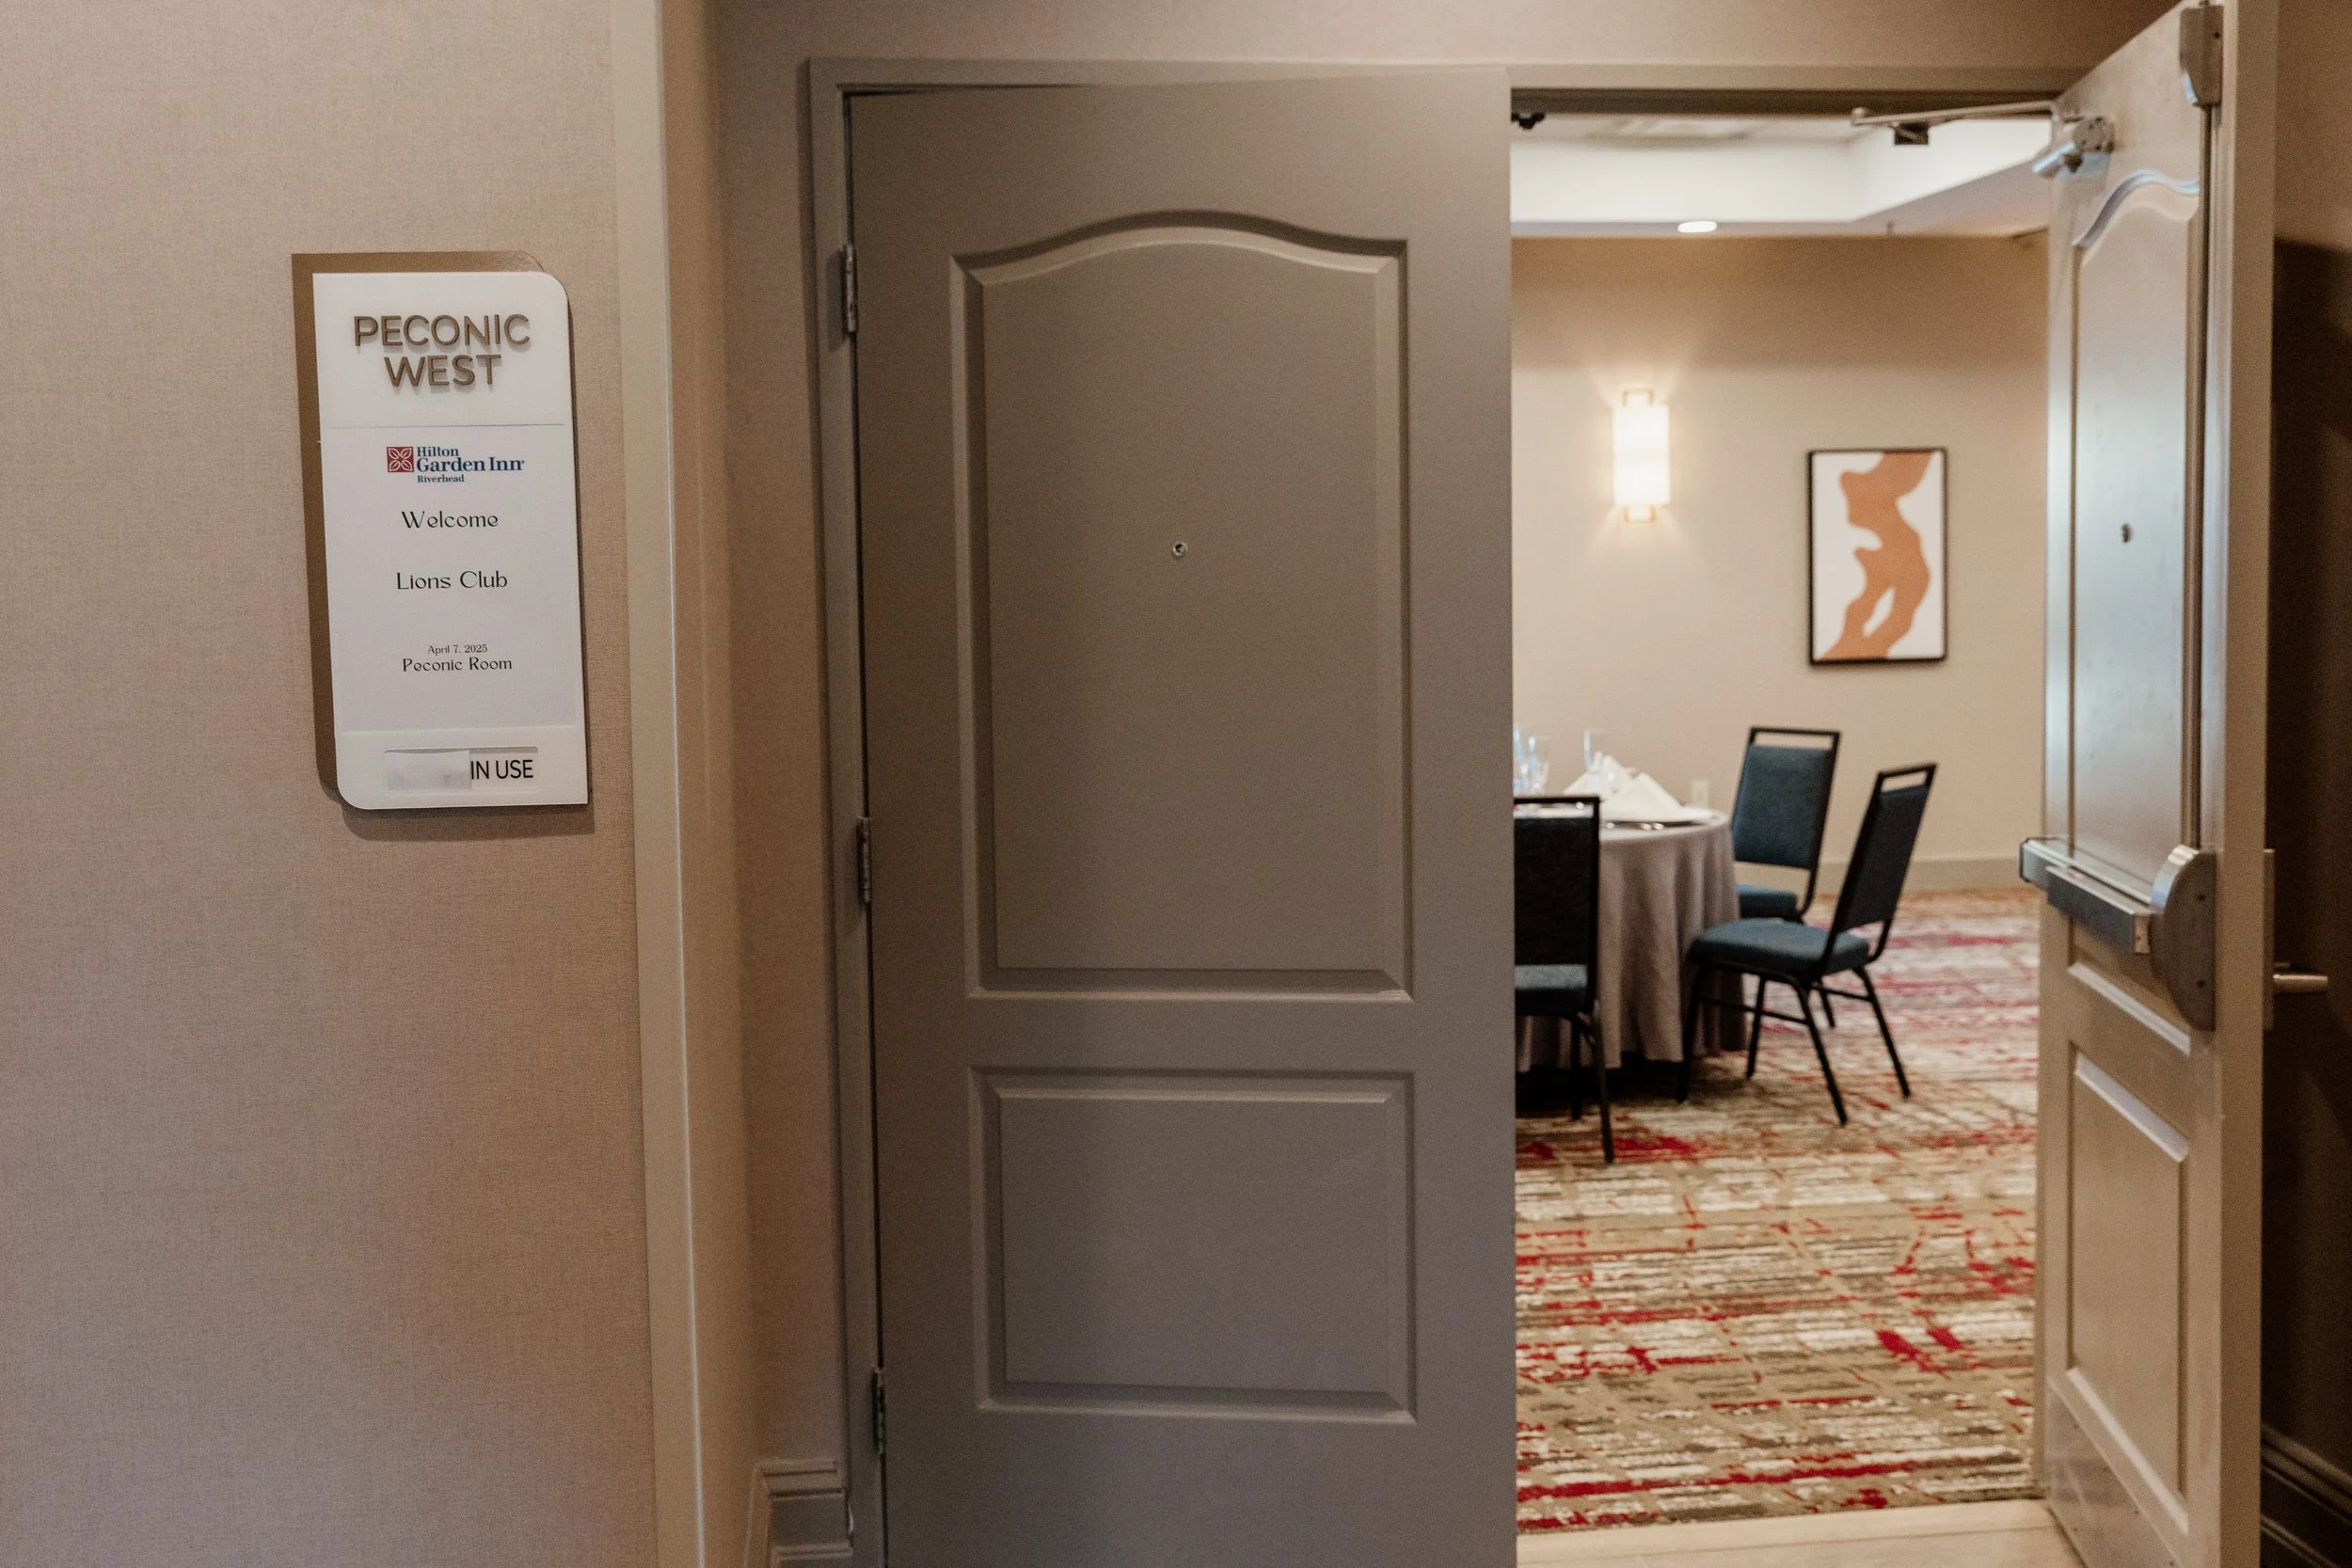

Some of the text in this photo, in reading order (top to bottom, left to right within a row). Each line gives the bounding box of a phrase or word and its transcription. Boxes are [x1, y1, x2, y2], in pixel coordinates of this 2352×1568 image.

[354, 314, 531, 347] PECONIC
[384, 354, 501, 388] WEST
[417, 446, 459, 457] Hilton
[416, 457, 486, 472] Garden
[417, 475, 465, 483] Riverhead
[401, 511, 499, 529] Welcome
[396, 570, 508, 590] Lions Club
[427, 645, 450, 656] April
[464, 644, 488, 654] 2025
[403, 657, 513, 673] Peconic Room
[470, 759, 534, 780] IN USE
